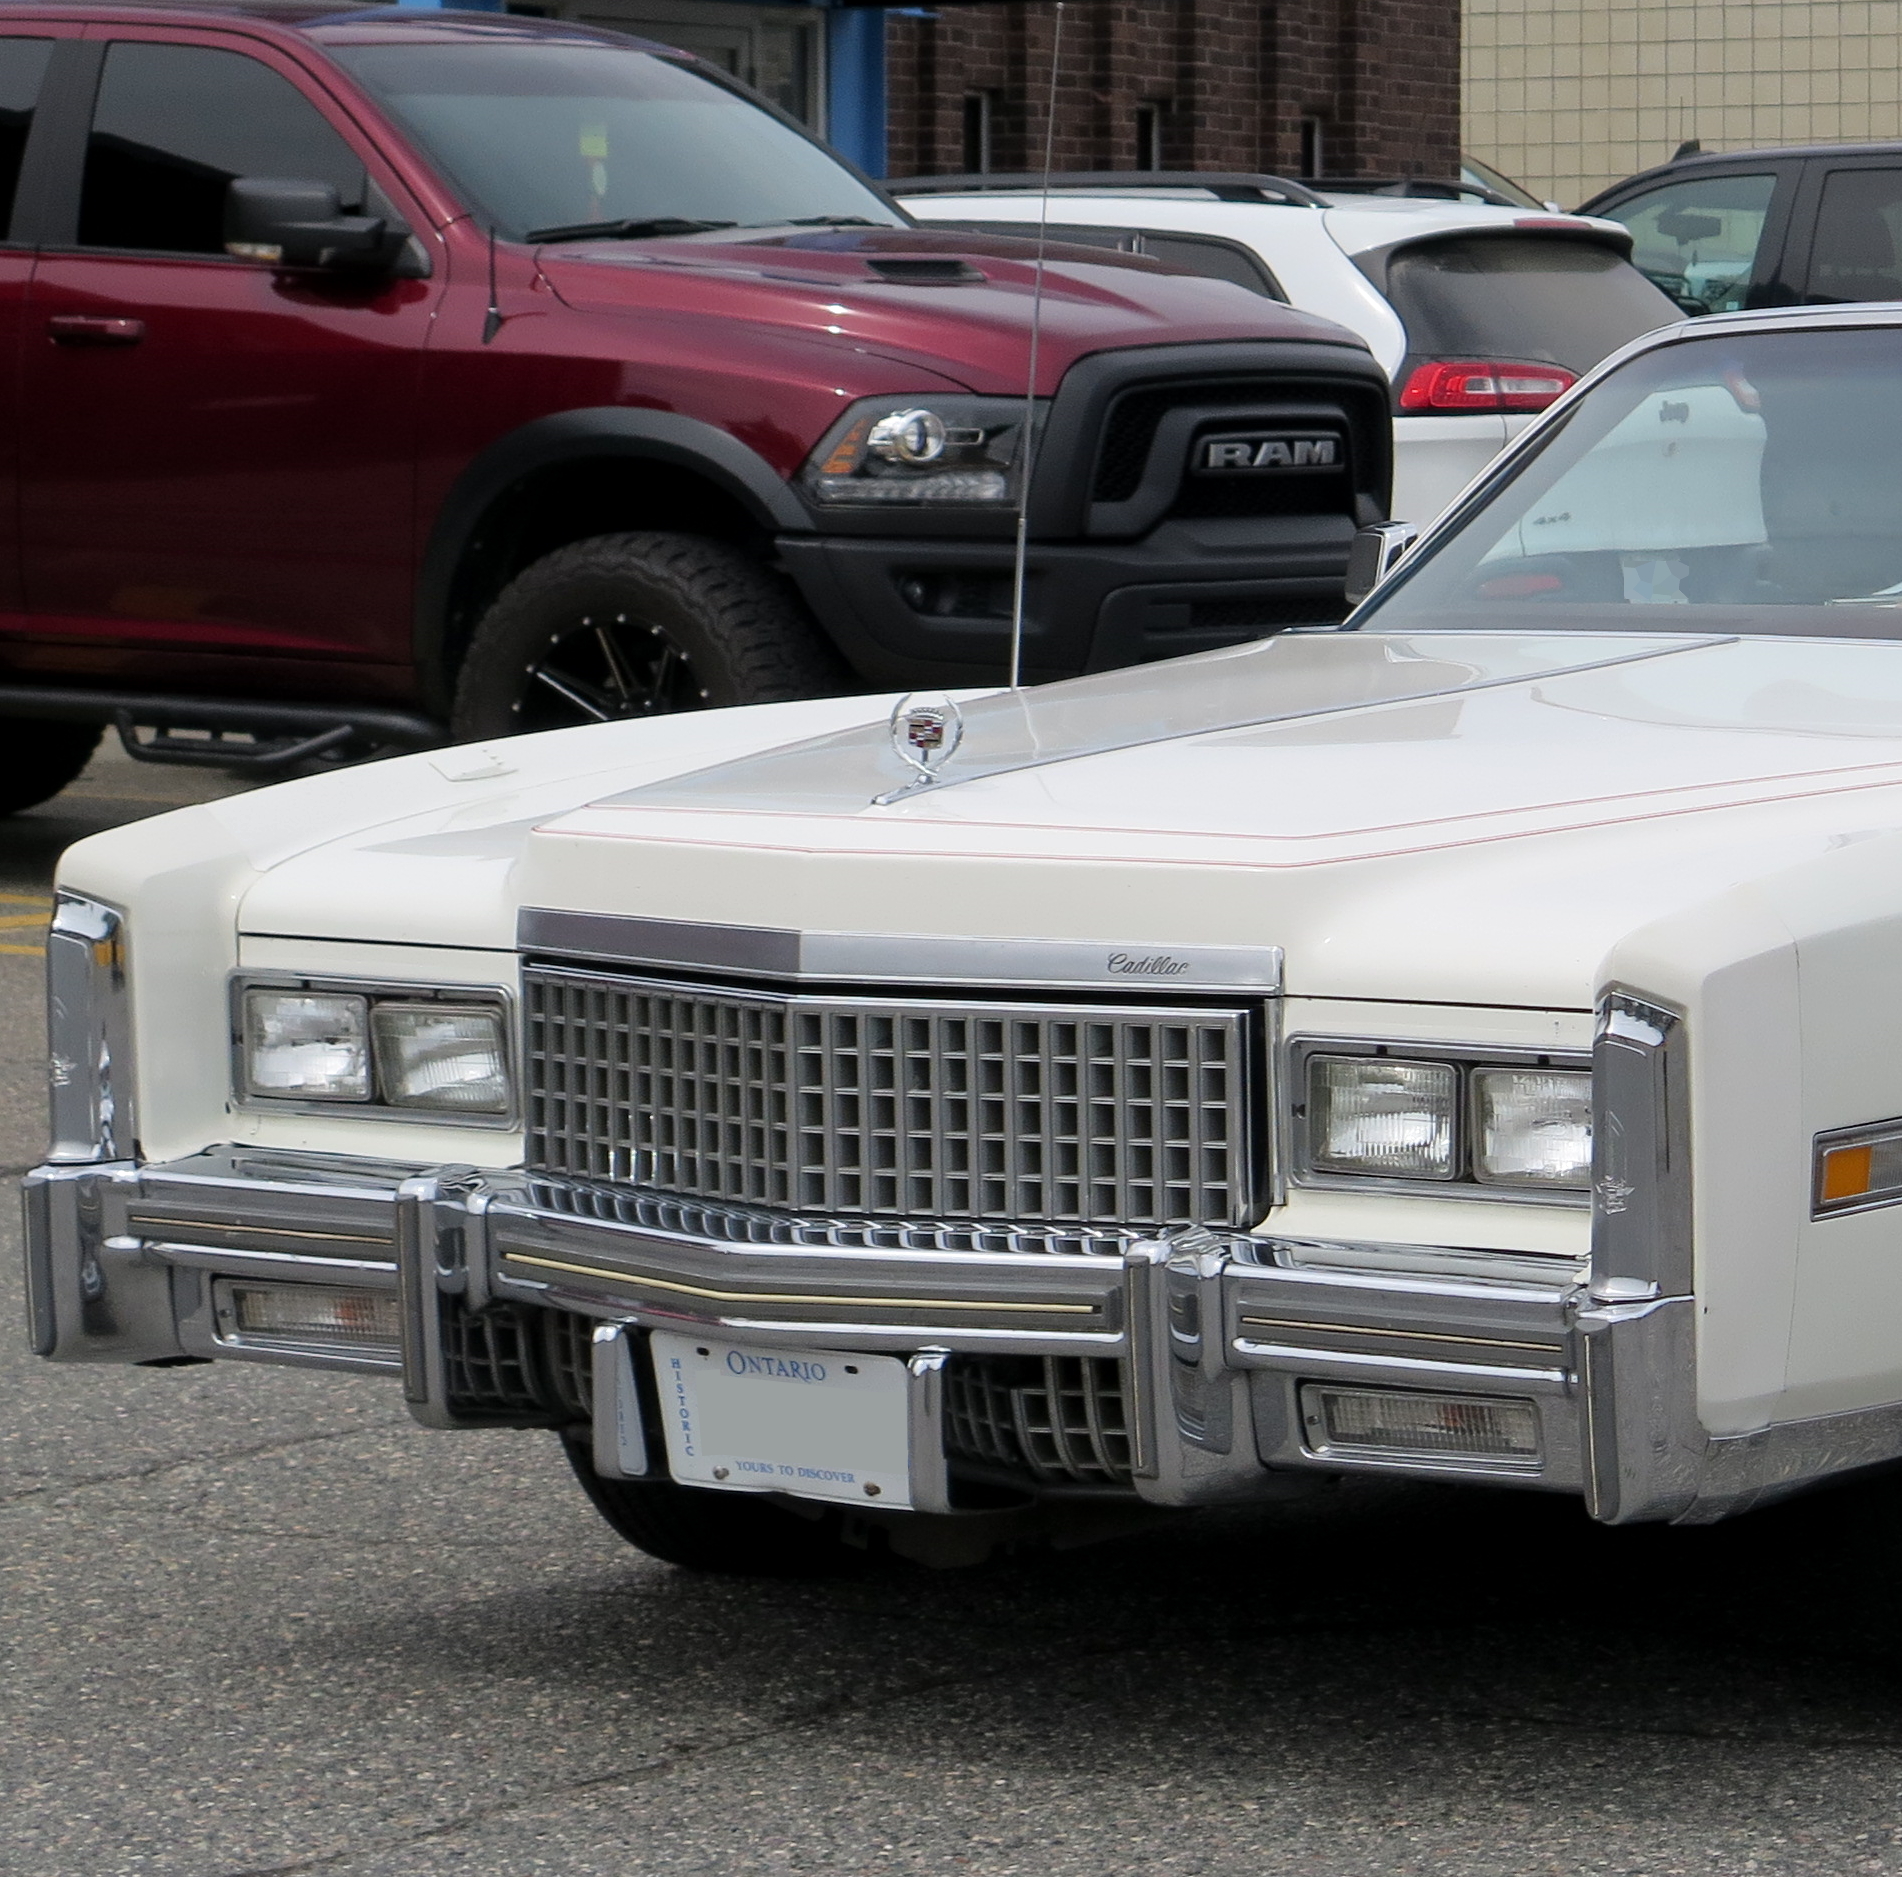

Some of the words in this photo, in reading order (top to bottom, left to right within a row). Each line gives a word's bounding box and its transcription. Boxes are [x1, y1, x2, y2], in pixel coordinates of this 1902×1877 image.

[1208, 440, 1335, 468] RAM
[1107, 952, 1190, 975] Cadillac
[670, 1358, 695, 1457] HISTORIC
[735, 1461, 774, 1474] YOURS
[778, 1465, 794, 1476] TO
[797, 1467, 856, 1483] DISCOVER
